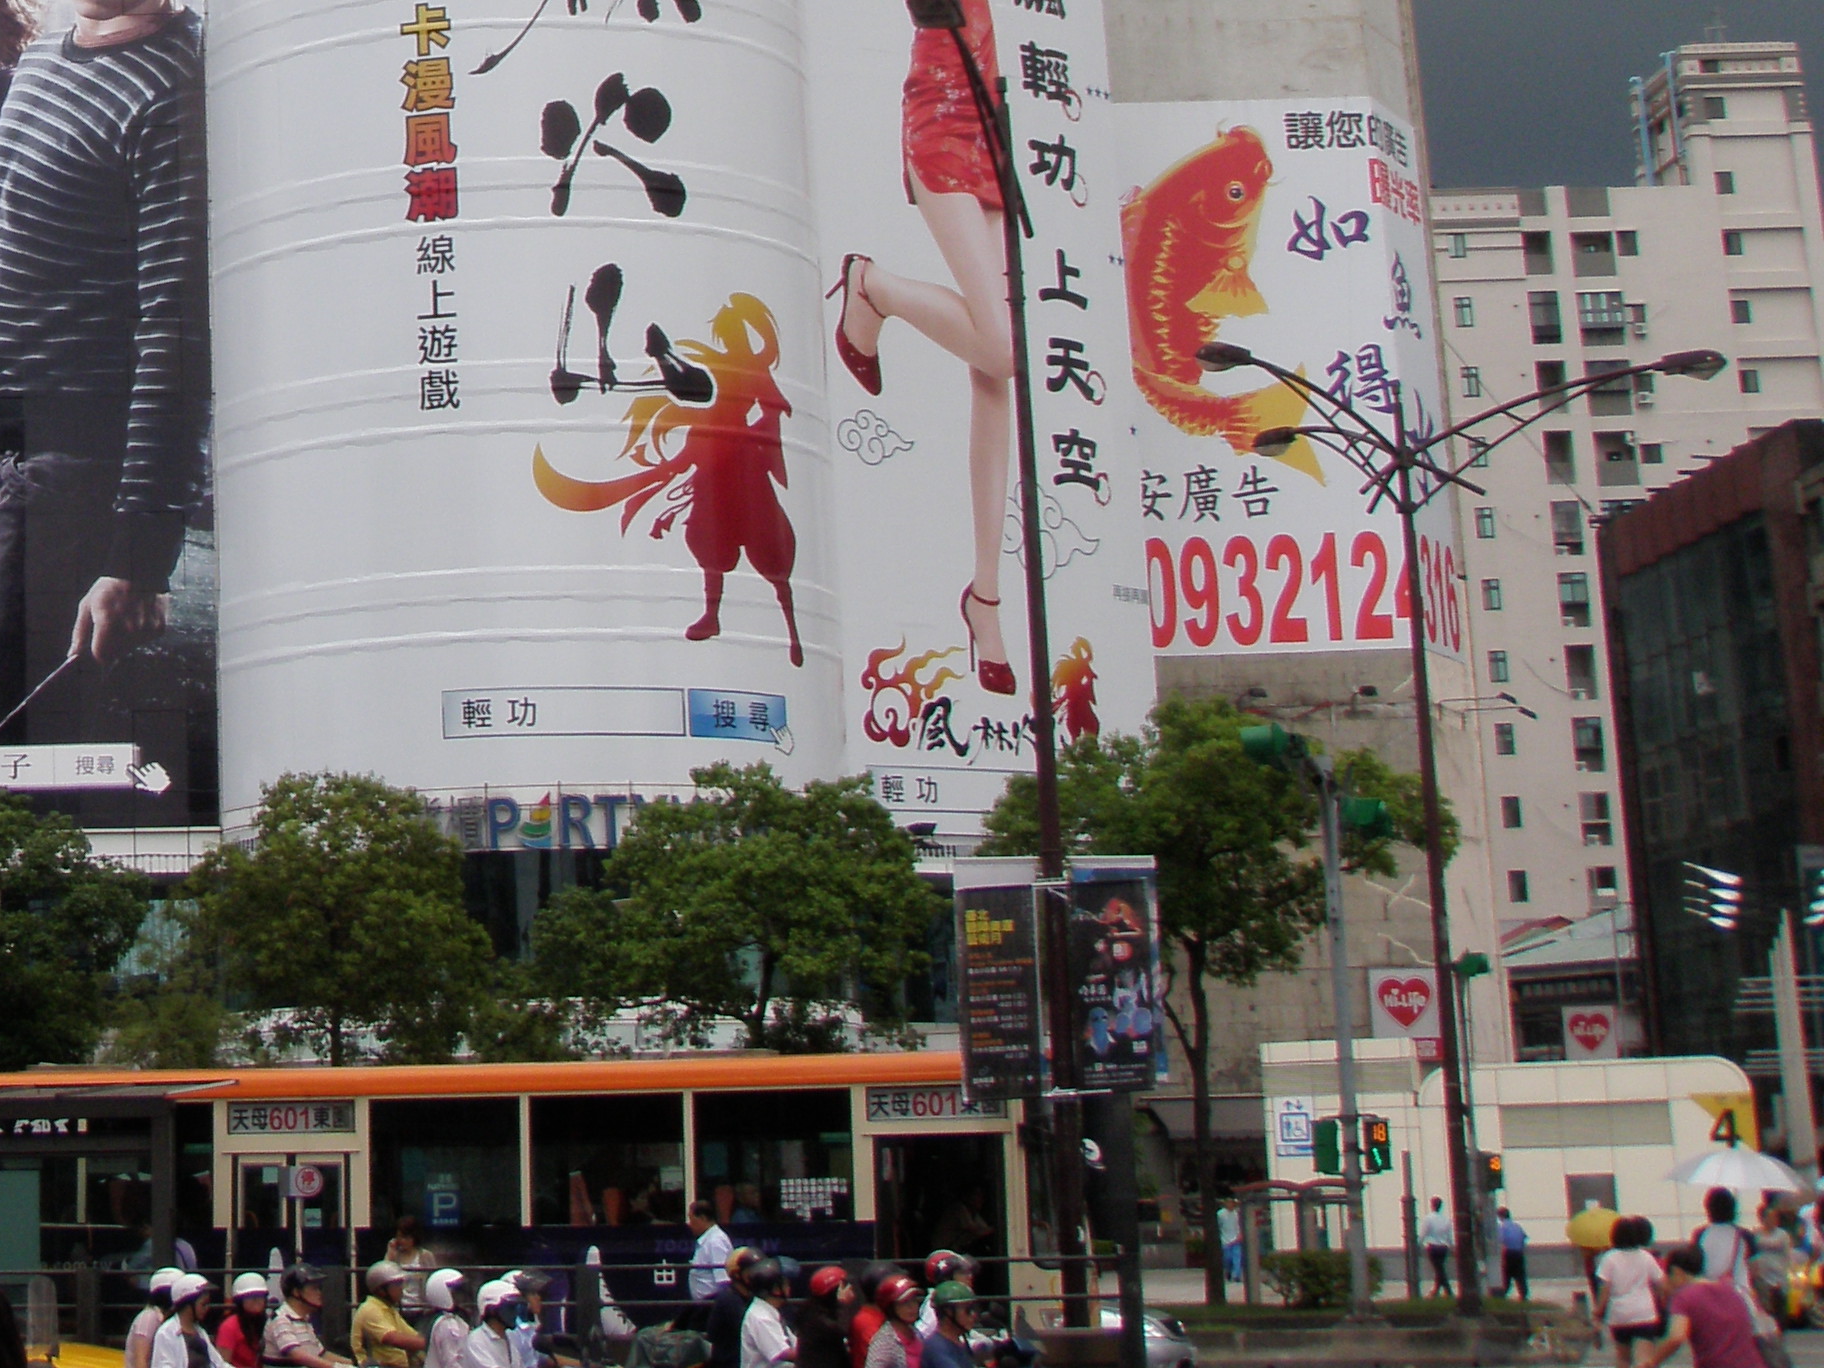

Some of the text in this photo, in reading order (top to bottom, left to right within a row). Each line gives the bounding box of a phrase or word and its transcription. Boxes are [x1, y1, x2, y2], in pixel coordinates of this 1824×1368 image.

[1039, 247, 1102, 492] 上天空
[461, 695, 538, 729] 輕功
[74, 755, 117, 777] 搜尋
[880, 773, 939, 805] 輕功
[1372, 1122, 1387, 1142] 18
[1708, 1107, 1741, 1146] 4
